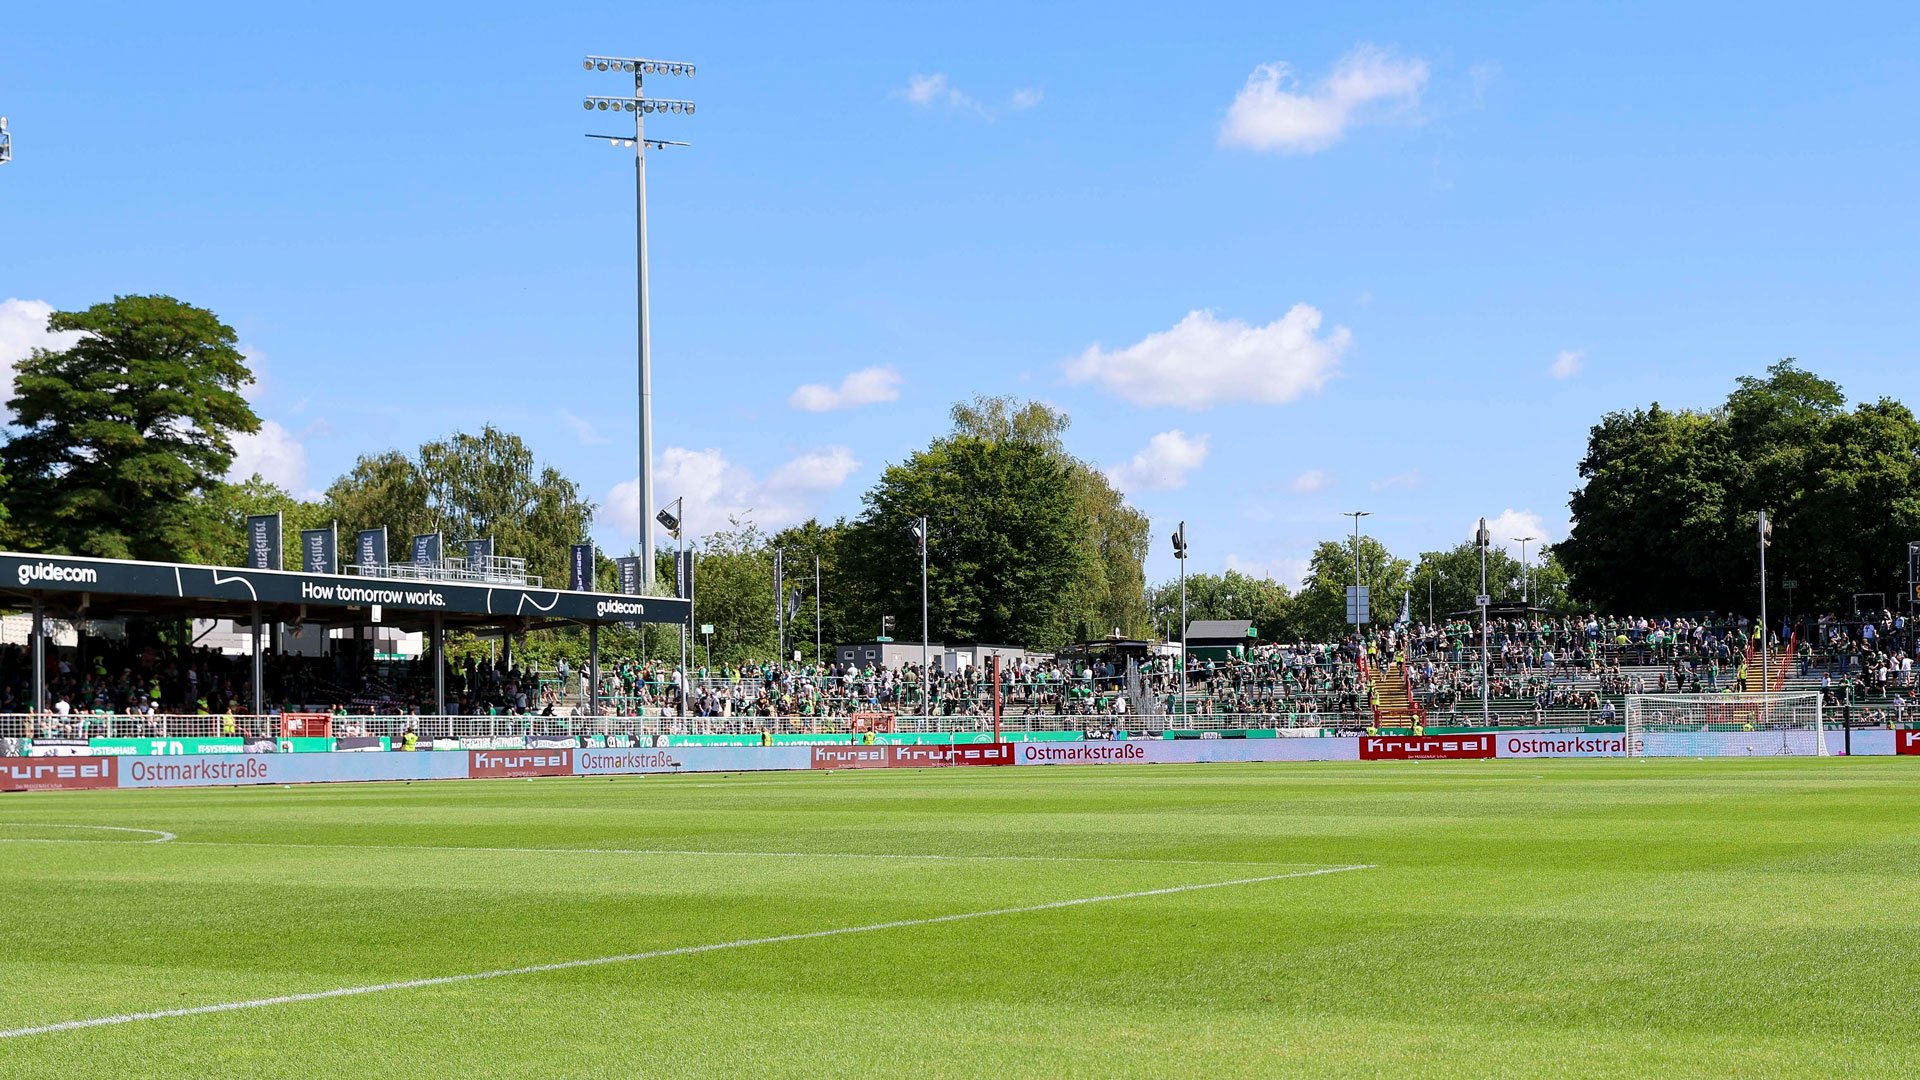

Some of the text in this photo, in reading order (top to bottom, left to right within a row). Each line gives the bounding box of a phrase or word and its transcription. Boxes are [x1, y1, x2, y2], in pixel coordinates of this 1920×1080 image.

[18, 562, 97, 585] guidecom
[302, 582, 446, 606] How tomorrow works.
[597, 600, 644, 616] guidecom
[1367, 737, 1487, 752] Krursel
[1906, 732, 1920, 747] K
[90, 747, 137, 755] SYSTEMHAUS
[816, 748, 885, 761] Krursel
[896, 745, 1008, 761] Krursel
[1025, 743, 1144, 761] Ostmarkstraße
[475, 751, 567, 769] Krursel
[582, 751, 672, 770] Ostmarkstraße
[131, 758, 267, 781] Ostmarkstraße
